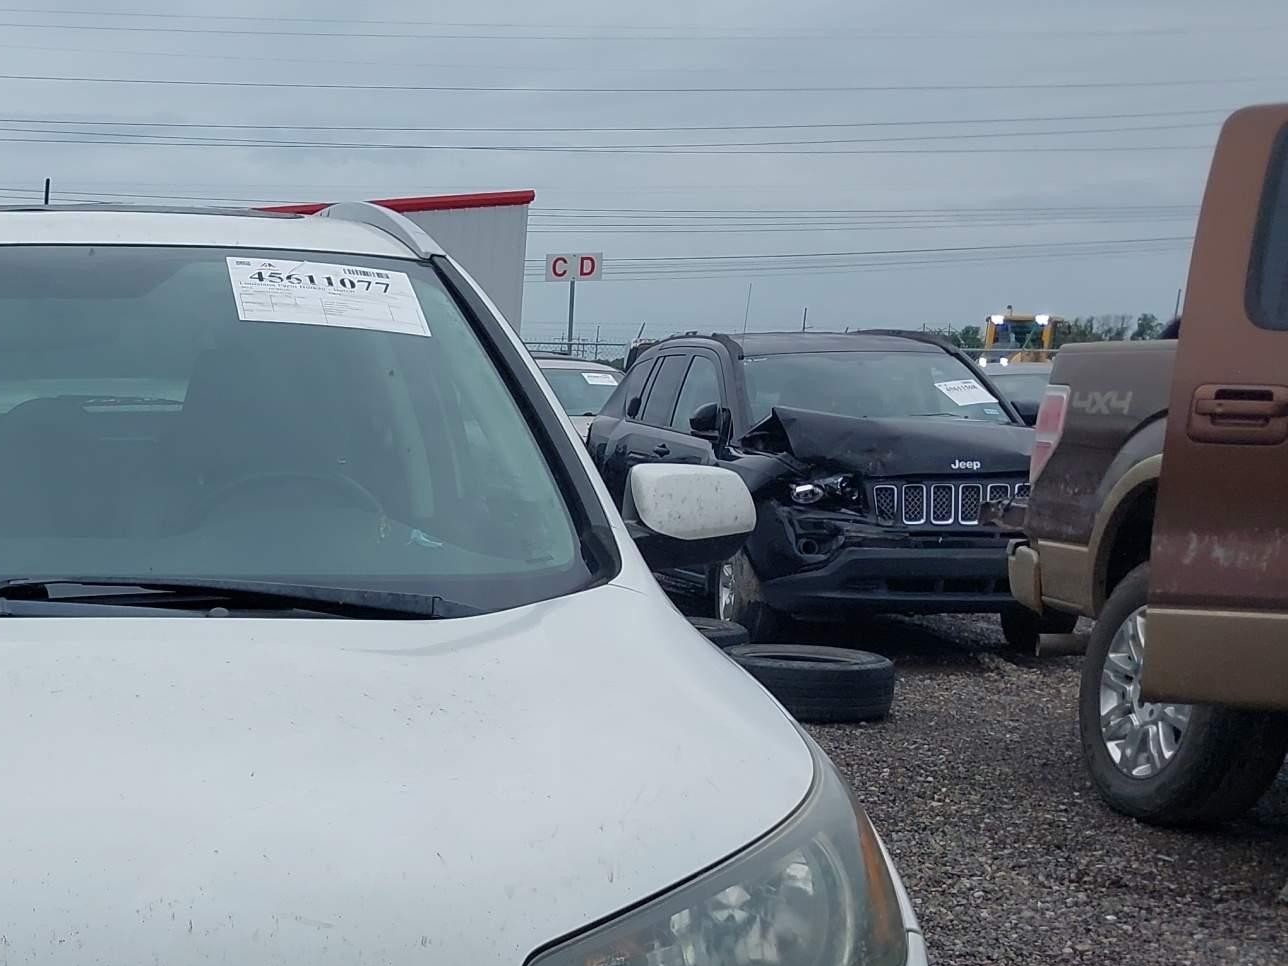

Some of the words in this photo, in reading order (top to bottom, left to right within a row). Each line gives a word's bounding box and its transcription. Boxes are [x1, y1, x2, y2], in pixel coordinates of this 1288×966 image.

[552, 256, 568, 277] C
[579, 256, 596, 276] D
[249, 271, 390, 294] 45611077
[951, 459, 981, 470] Jeep
